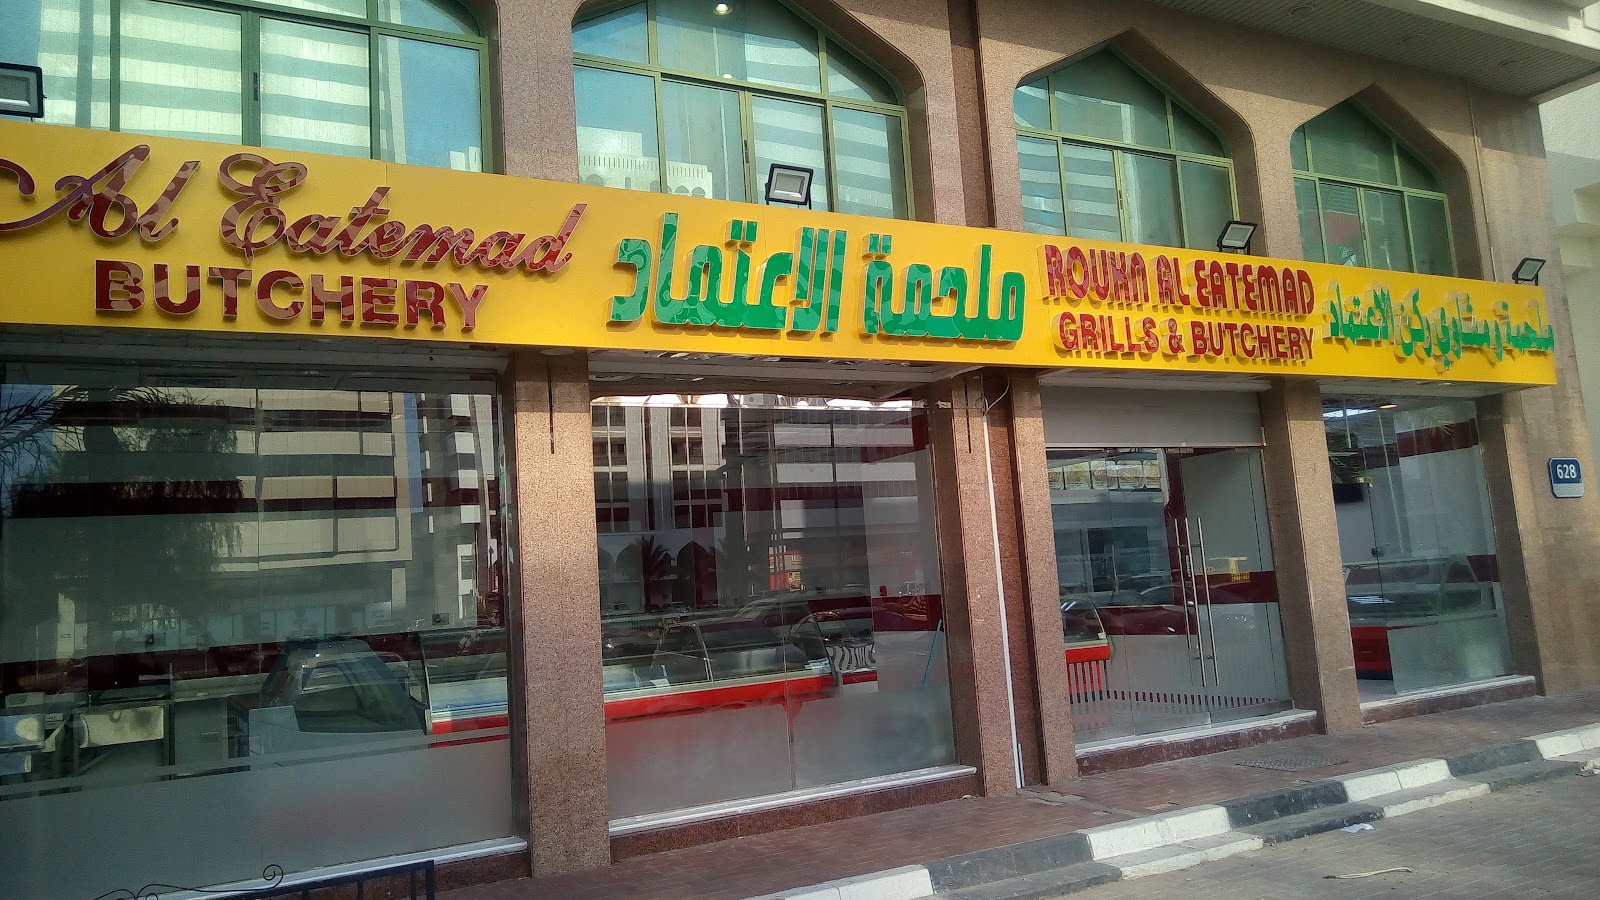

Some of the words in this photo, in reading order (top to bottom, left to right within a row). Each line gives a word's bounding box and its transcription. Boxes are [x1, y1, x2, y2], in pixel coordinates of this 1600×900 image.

[0, 144, 201, 243] Al
[217, 153, 588, 274] Eatemad
[95, 259, 489, 331] BUTCHERY
[607, 212, 848, 333] الاعتماد
[860, 233, 1026, 341] ملحمة
[1043, 244, 1150, 303] ROUKN
[1155, 254, 1191, 306] AL
[1193, 259, 1315, 315] EATEMAD
[1057, 311, 1160, 354] GRILLS
[1167, 317, 1186, 354] &
[1190, 320, 1314, 360] BUTCHERY
[1326, 277, 1396, 346] الاعتماد
[1556, 464, 1577, 479] 628
